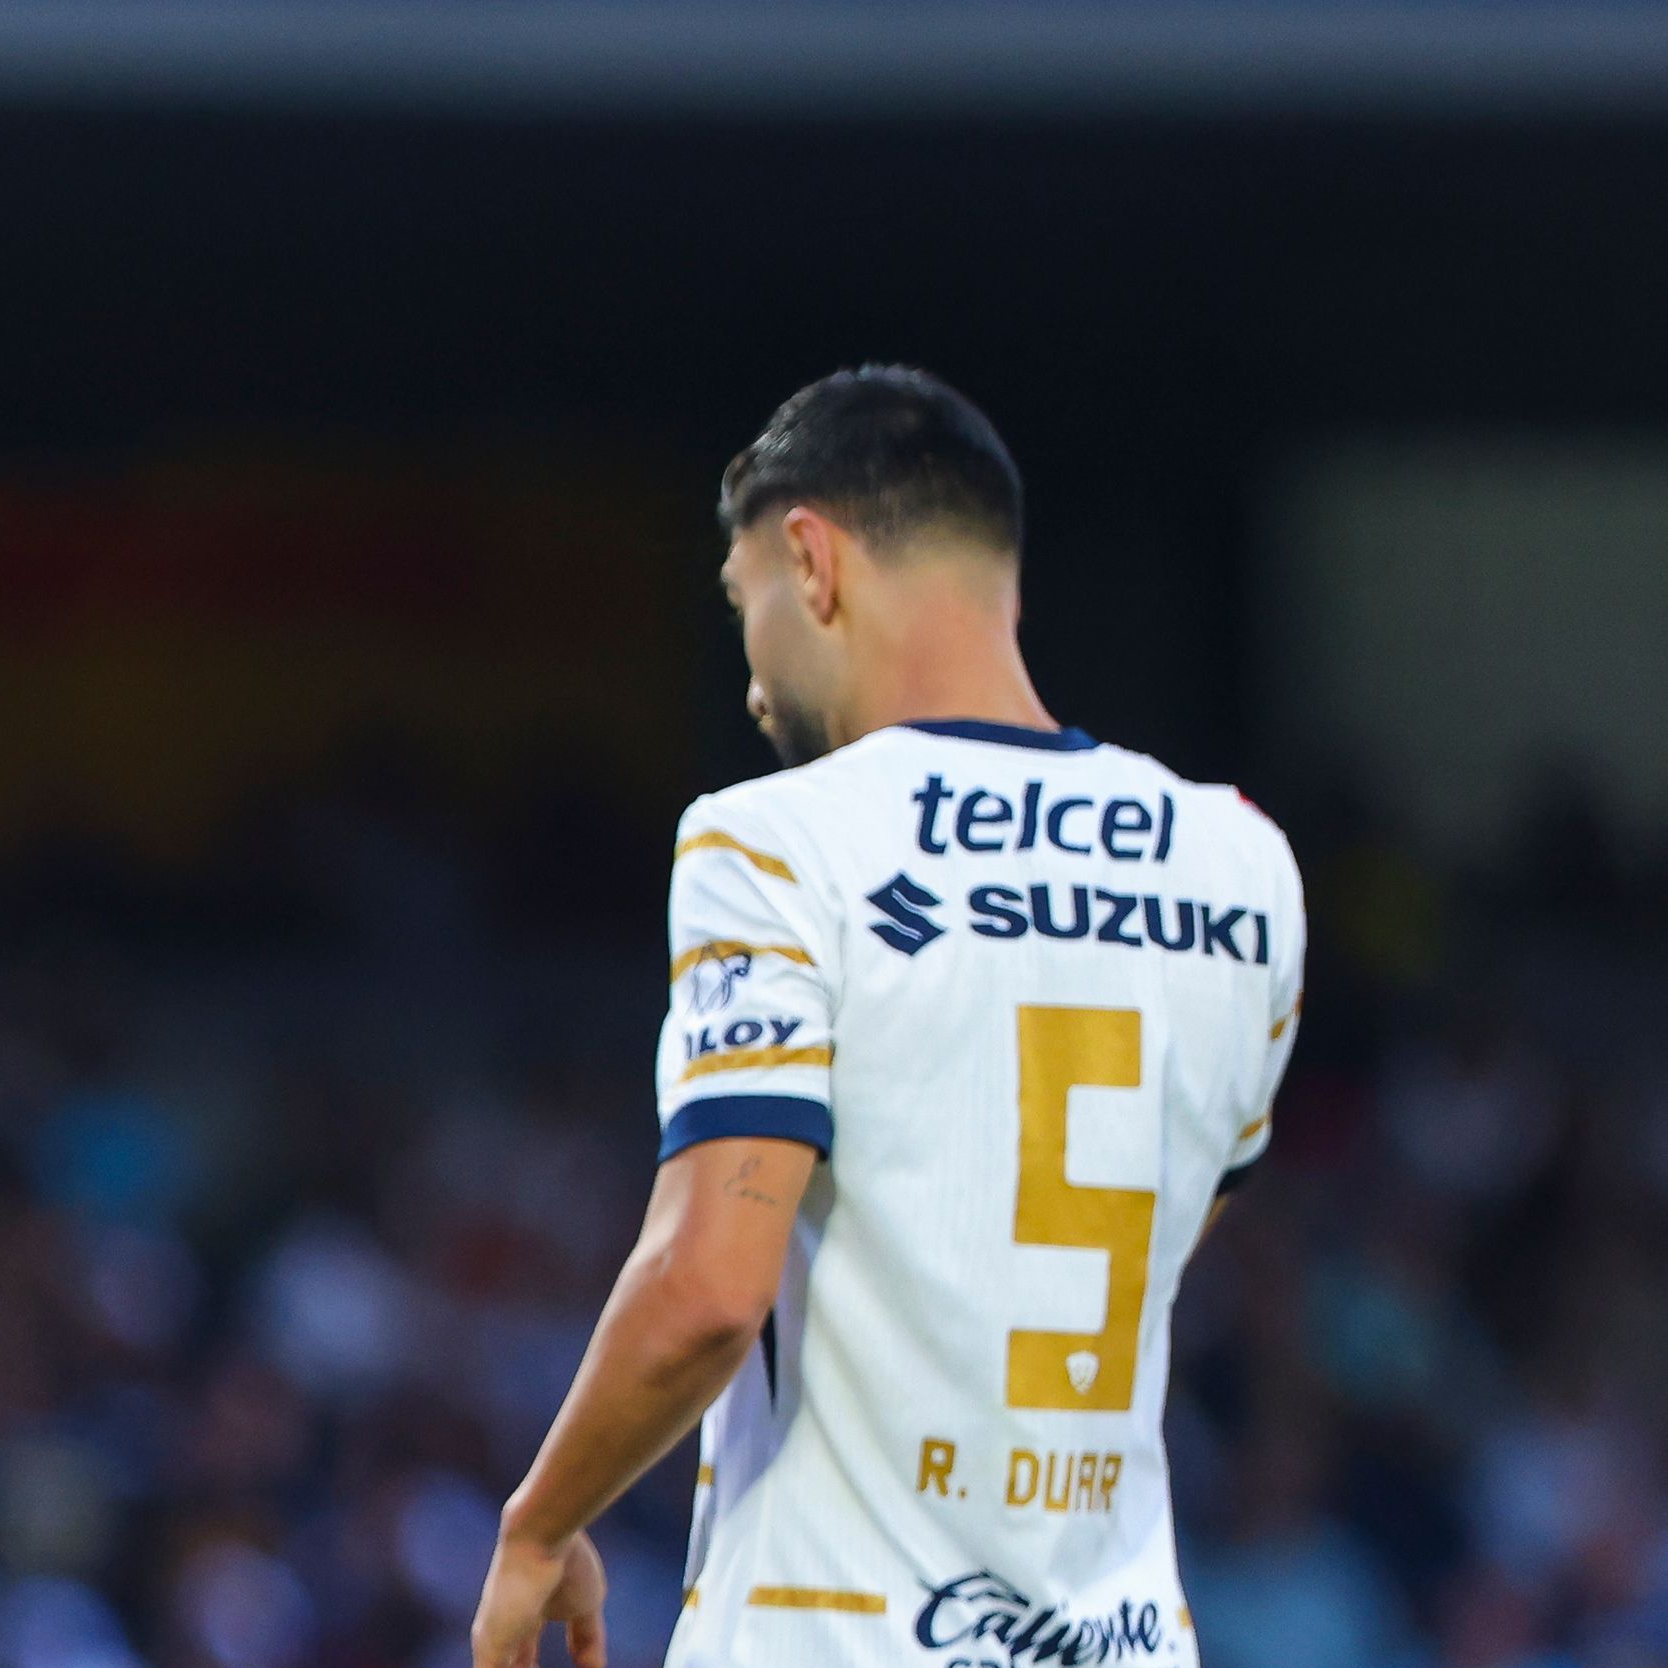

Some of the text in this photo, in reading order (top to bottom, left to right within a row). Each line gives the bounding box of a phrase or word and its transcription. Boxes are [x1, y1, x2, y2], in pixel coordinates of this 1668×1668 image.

[912, 773, 1173, 863] telcel
[966, 884, 1268, 965] SUZUKI
[1005, 1003, 1156, 1411] 5
[917, 1436, 967, 1499] R.
